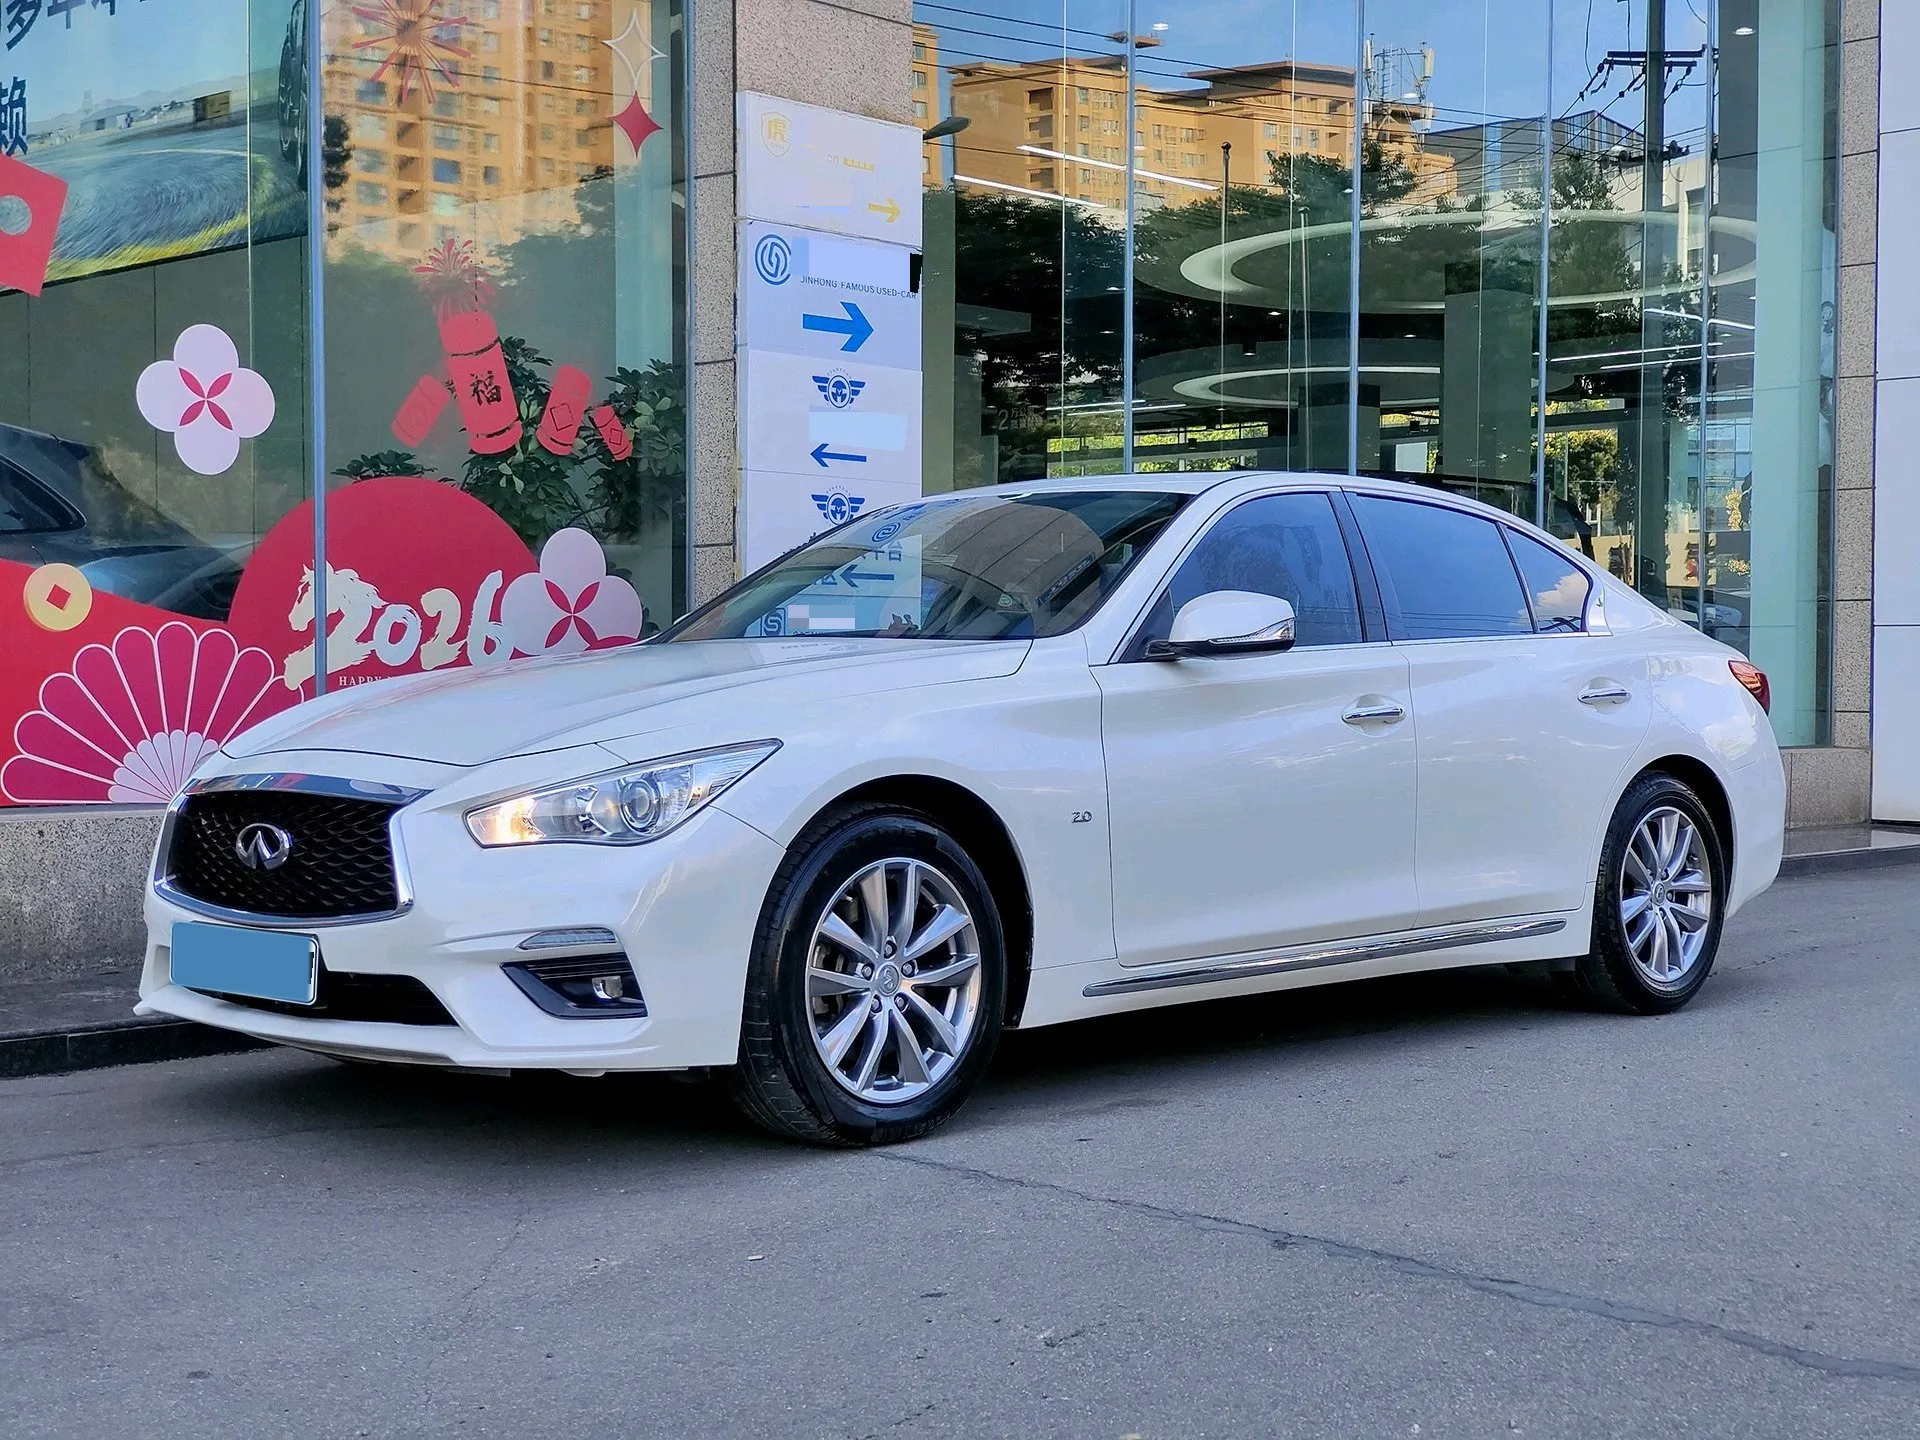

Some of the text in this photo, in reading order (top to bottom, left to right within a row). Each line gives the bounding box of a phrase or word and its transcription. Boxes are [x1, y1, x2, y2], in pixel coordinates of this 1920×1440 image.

[800, 275, 917, 300] JINHONG FAMOUS USED-CAR
[470, 370, 502, 406] 福
[283, 560, 515, 691] 2026
